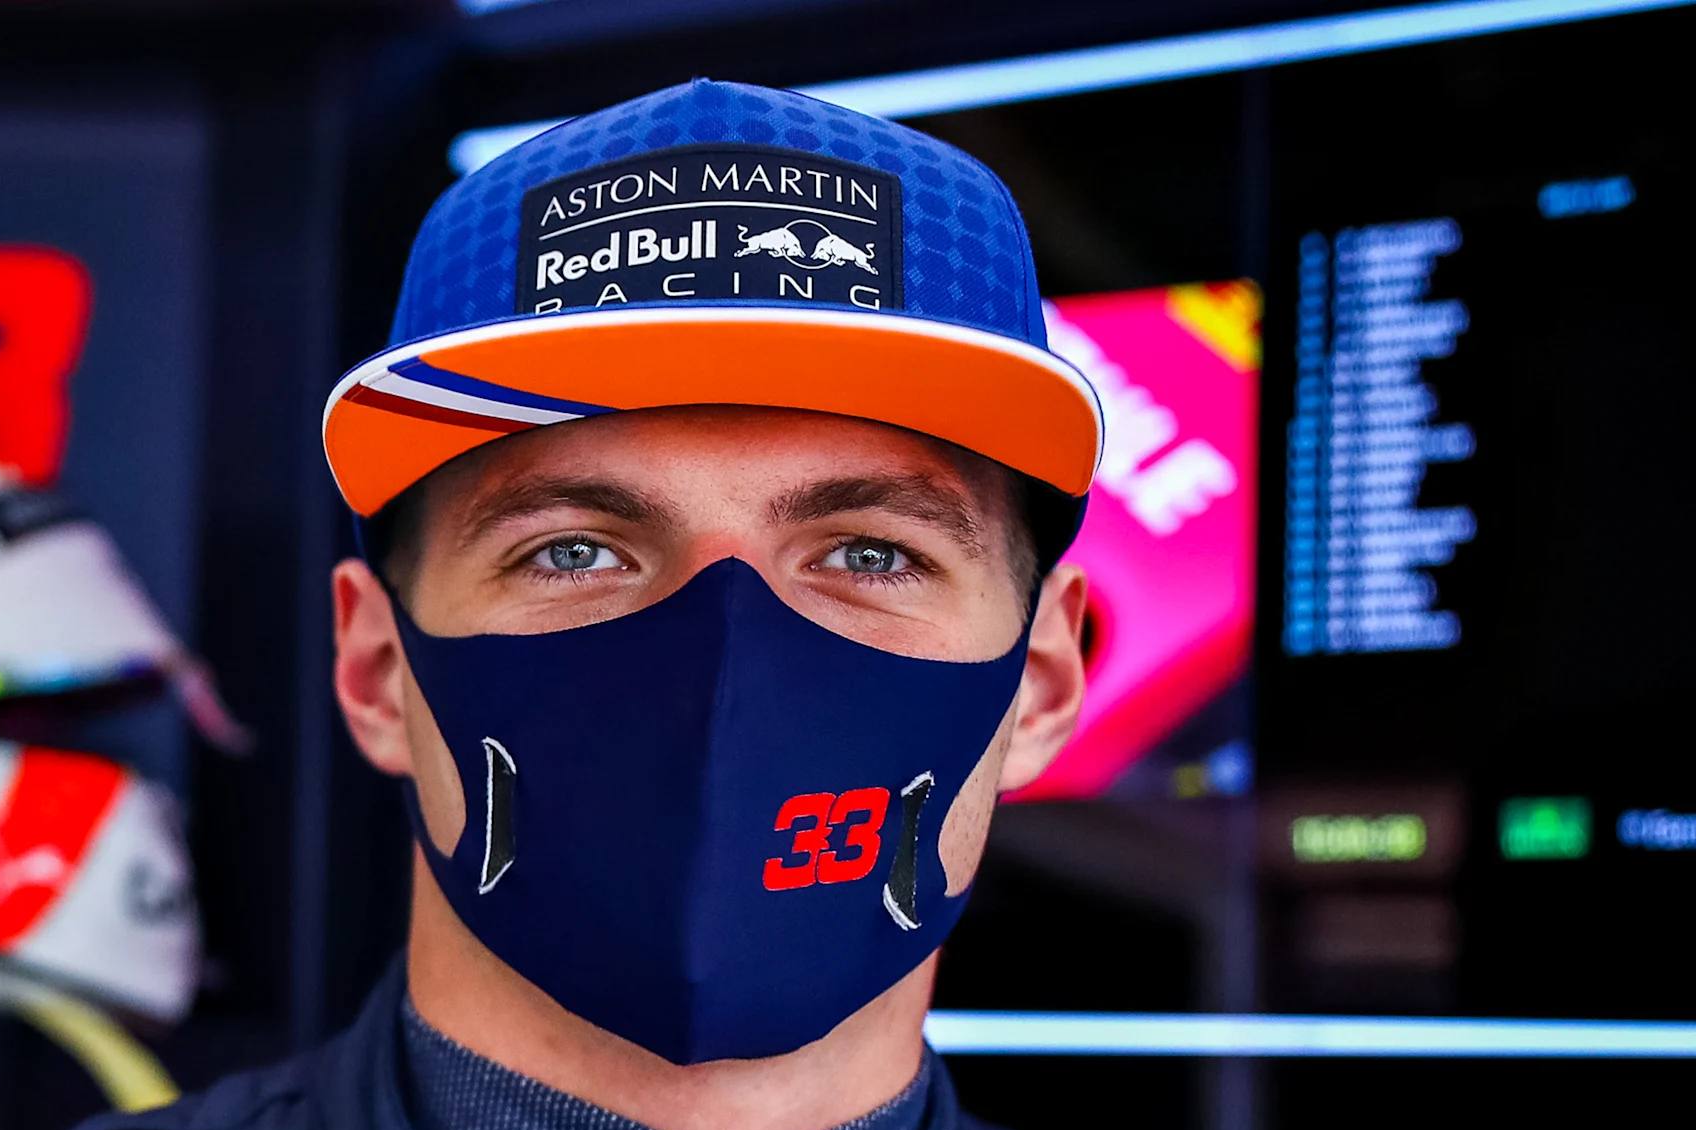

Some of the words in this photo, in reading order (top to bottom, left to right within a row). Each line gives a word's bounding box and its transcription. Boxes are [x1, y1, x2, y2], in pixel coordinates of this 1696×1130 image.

[540, 167, 678, 227] ASTON
[701, 163, 879, 212] MARTIN
[536, 230, 621, 291] Red
[627, 220, 718, 263] Bull
[534, 271, 881, 316] RACING
[762, 787, 891, 891] 33
